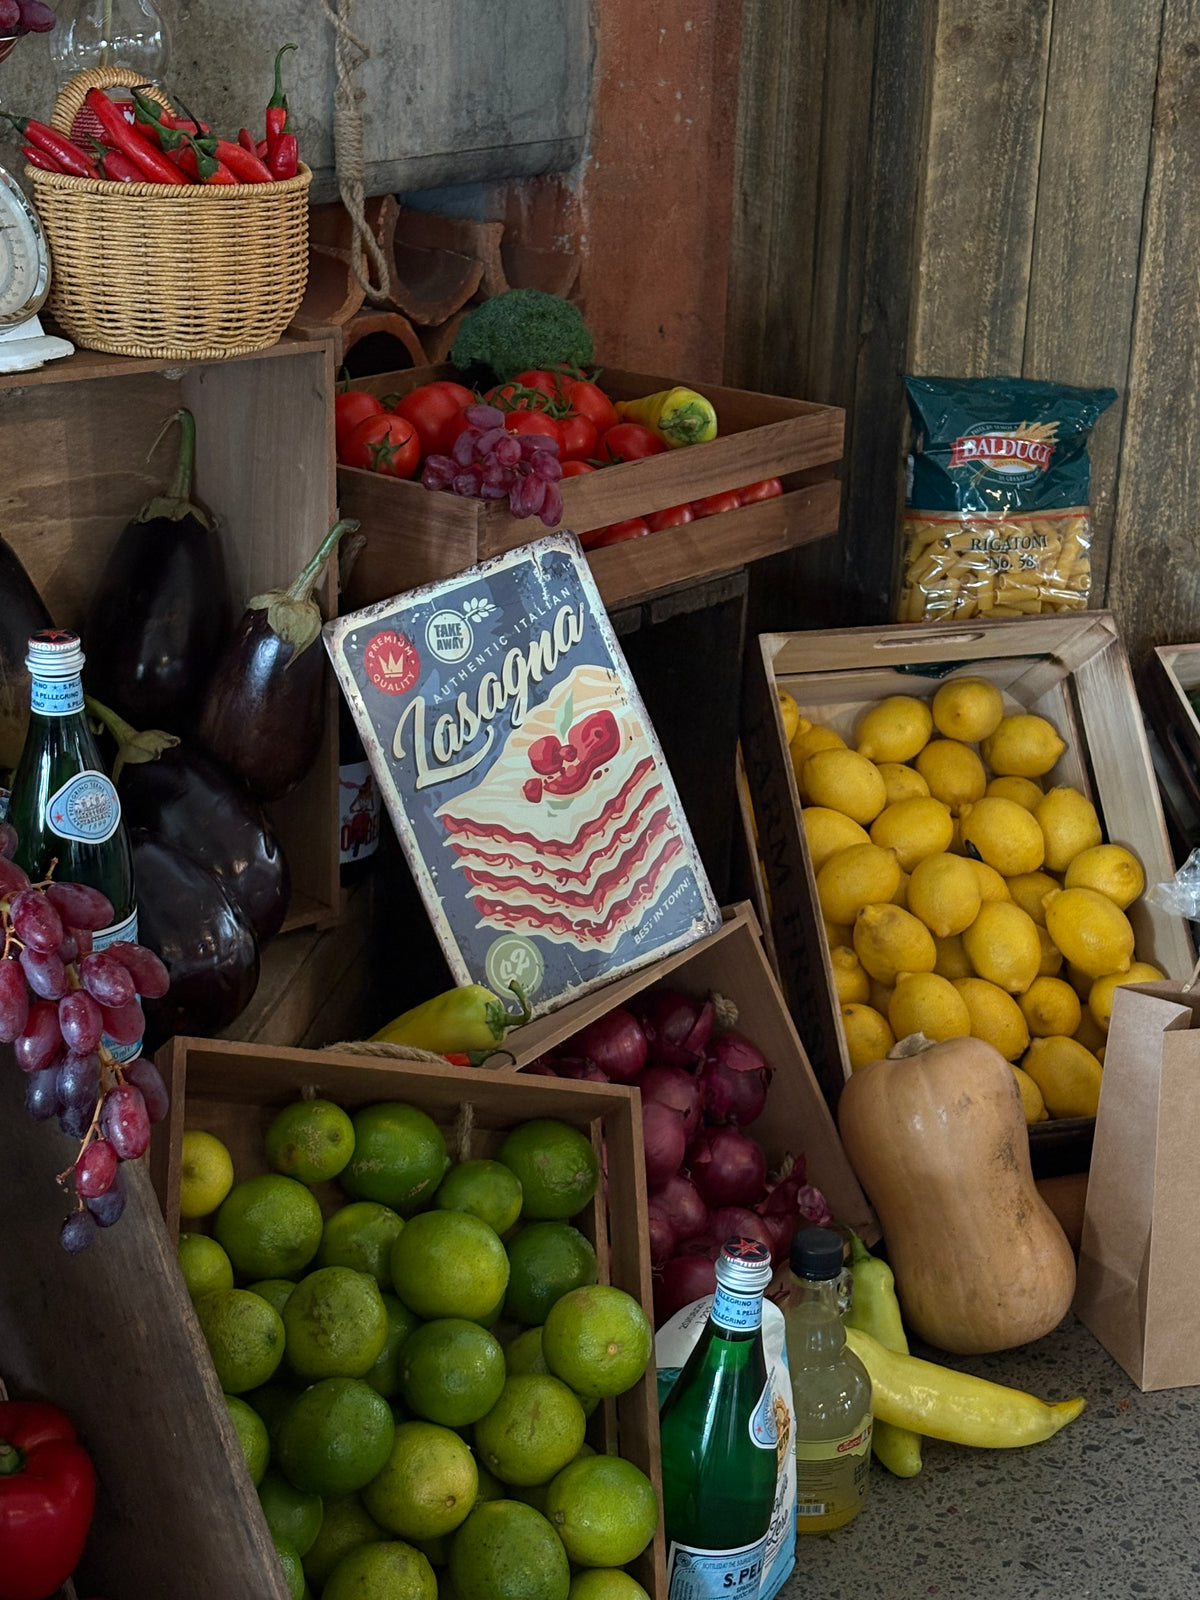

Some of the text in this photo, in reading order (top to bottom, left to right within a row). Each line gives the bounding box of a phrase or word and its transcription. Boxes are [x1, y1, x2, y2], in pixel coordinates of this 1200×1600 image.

[962, 438, 1051, 463] BALDUCCI
[971, 535, 1048, 551] RIGATONI
[987, 556, 1013, 569] No.
[434, 622, 463, 638] TAKE
[368, 634, 413, 659] PREMIUM
[432, 586, 571, 705] AUTHENTIC ITALIAN
[436, 636, 465, 651] AWAY
[372, 671, 416, 692] QUALITY
[393, 602, 585, 790] Lasagna
[633, 877, 691, 945] BEST IN TOWN!
